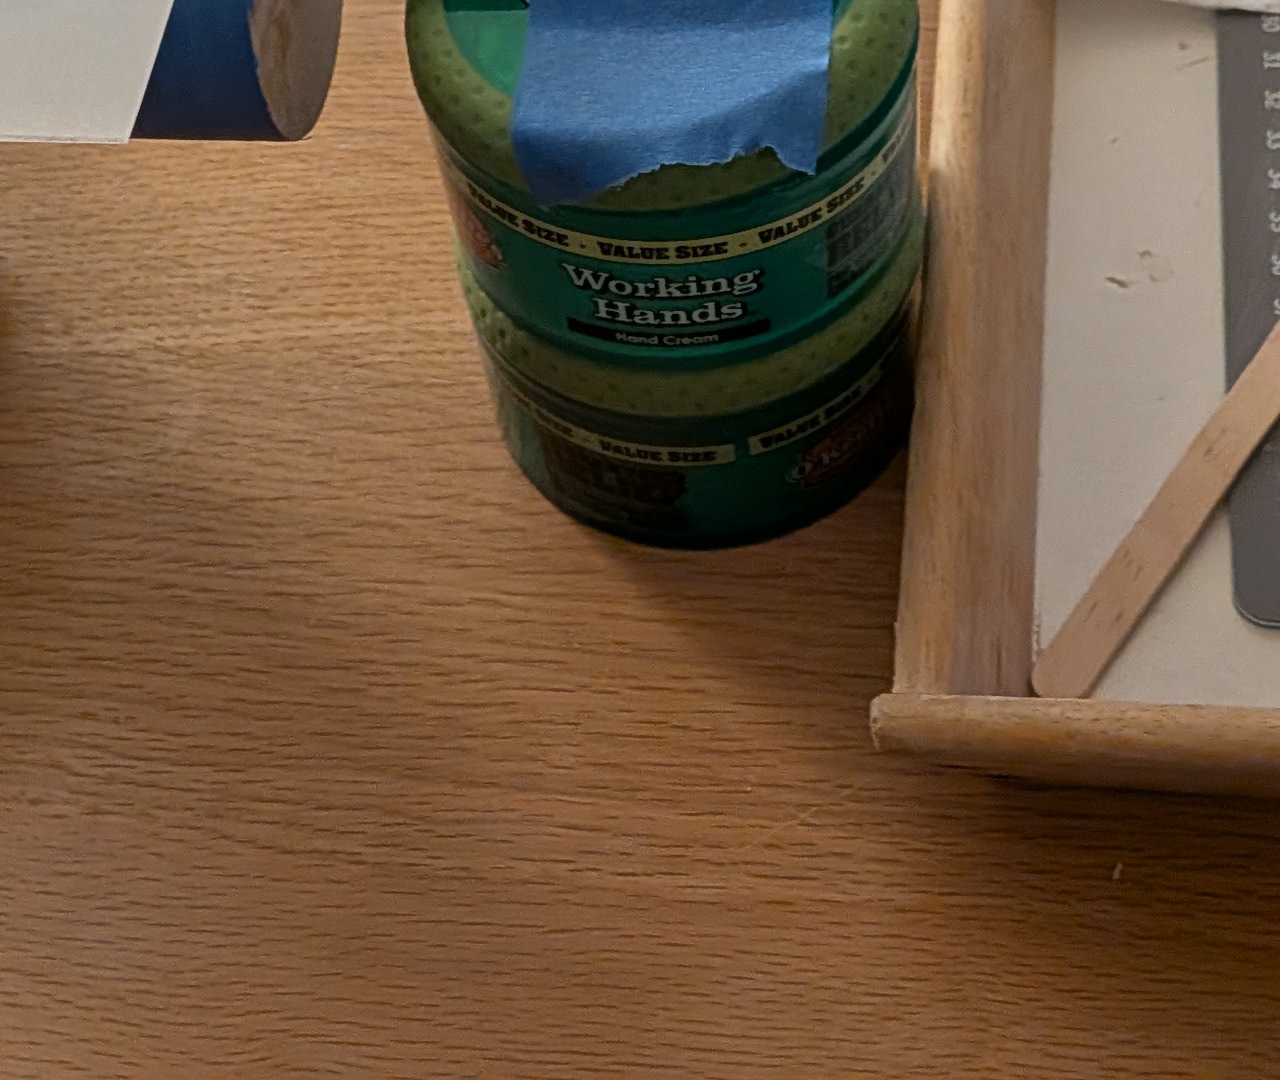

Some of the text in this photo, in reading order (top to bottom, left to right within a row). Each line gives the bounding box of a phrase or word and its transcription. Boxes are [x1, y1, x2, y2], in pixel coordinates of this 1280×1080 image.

[522, 218, 570, 248] SIZE
[597, 241, 670, 260] VALUE
[674, 241, 729, 260] SIZE
[758, 206, 824, 244] VALUE
[826, 175, 866, 214] SIZE
[561, 262, 761, 298] Working
[593, 297, 744, 325] Hands
[616, 332, 720, 346] Hand Cream
[597, 440, 664, 463] VALUE
[666, 449, 718, 464] SIZE
[757, 415, 821, 448] VALUE
